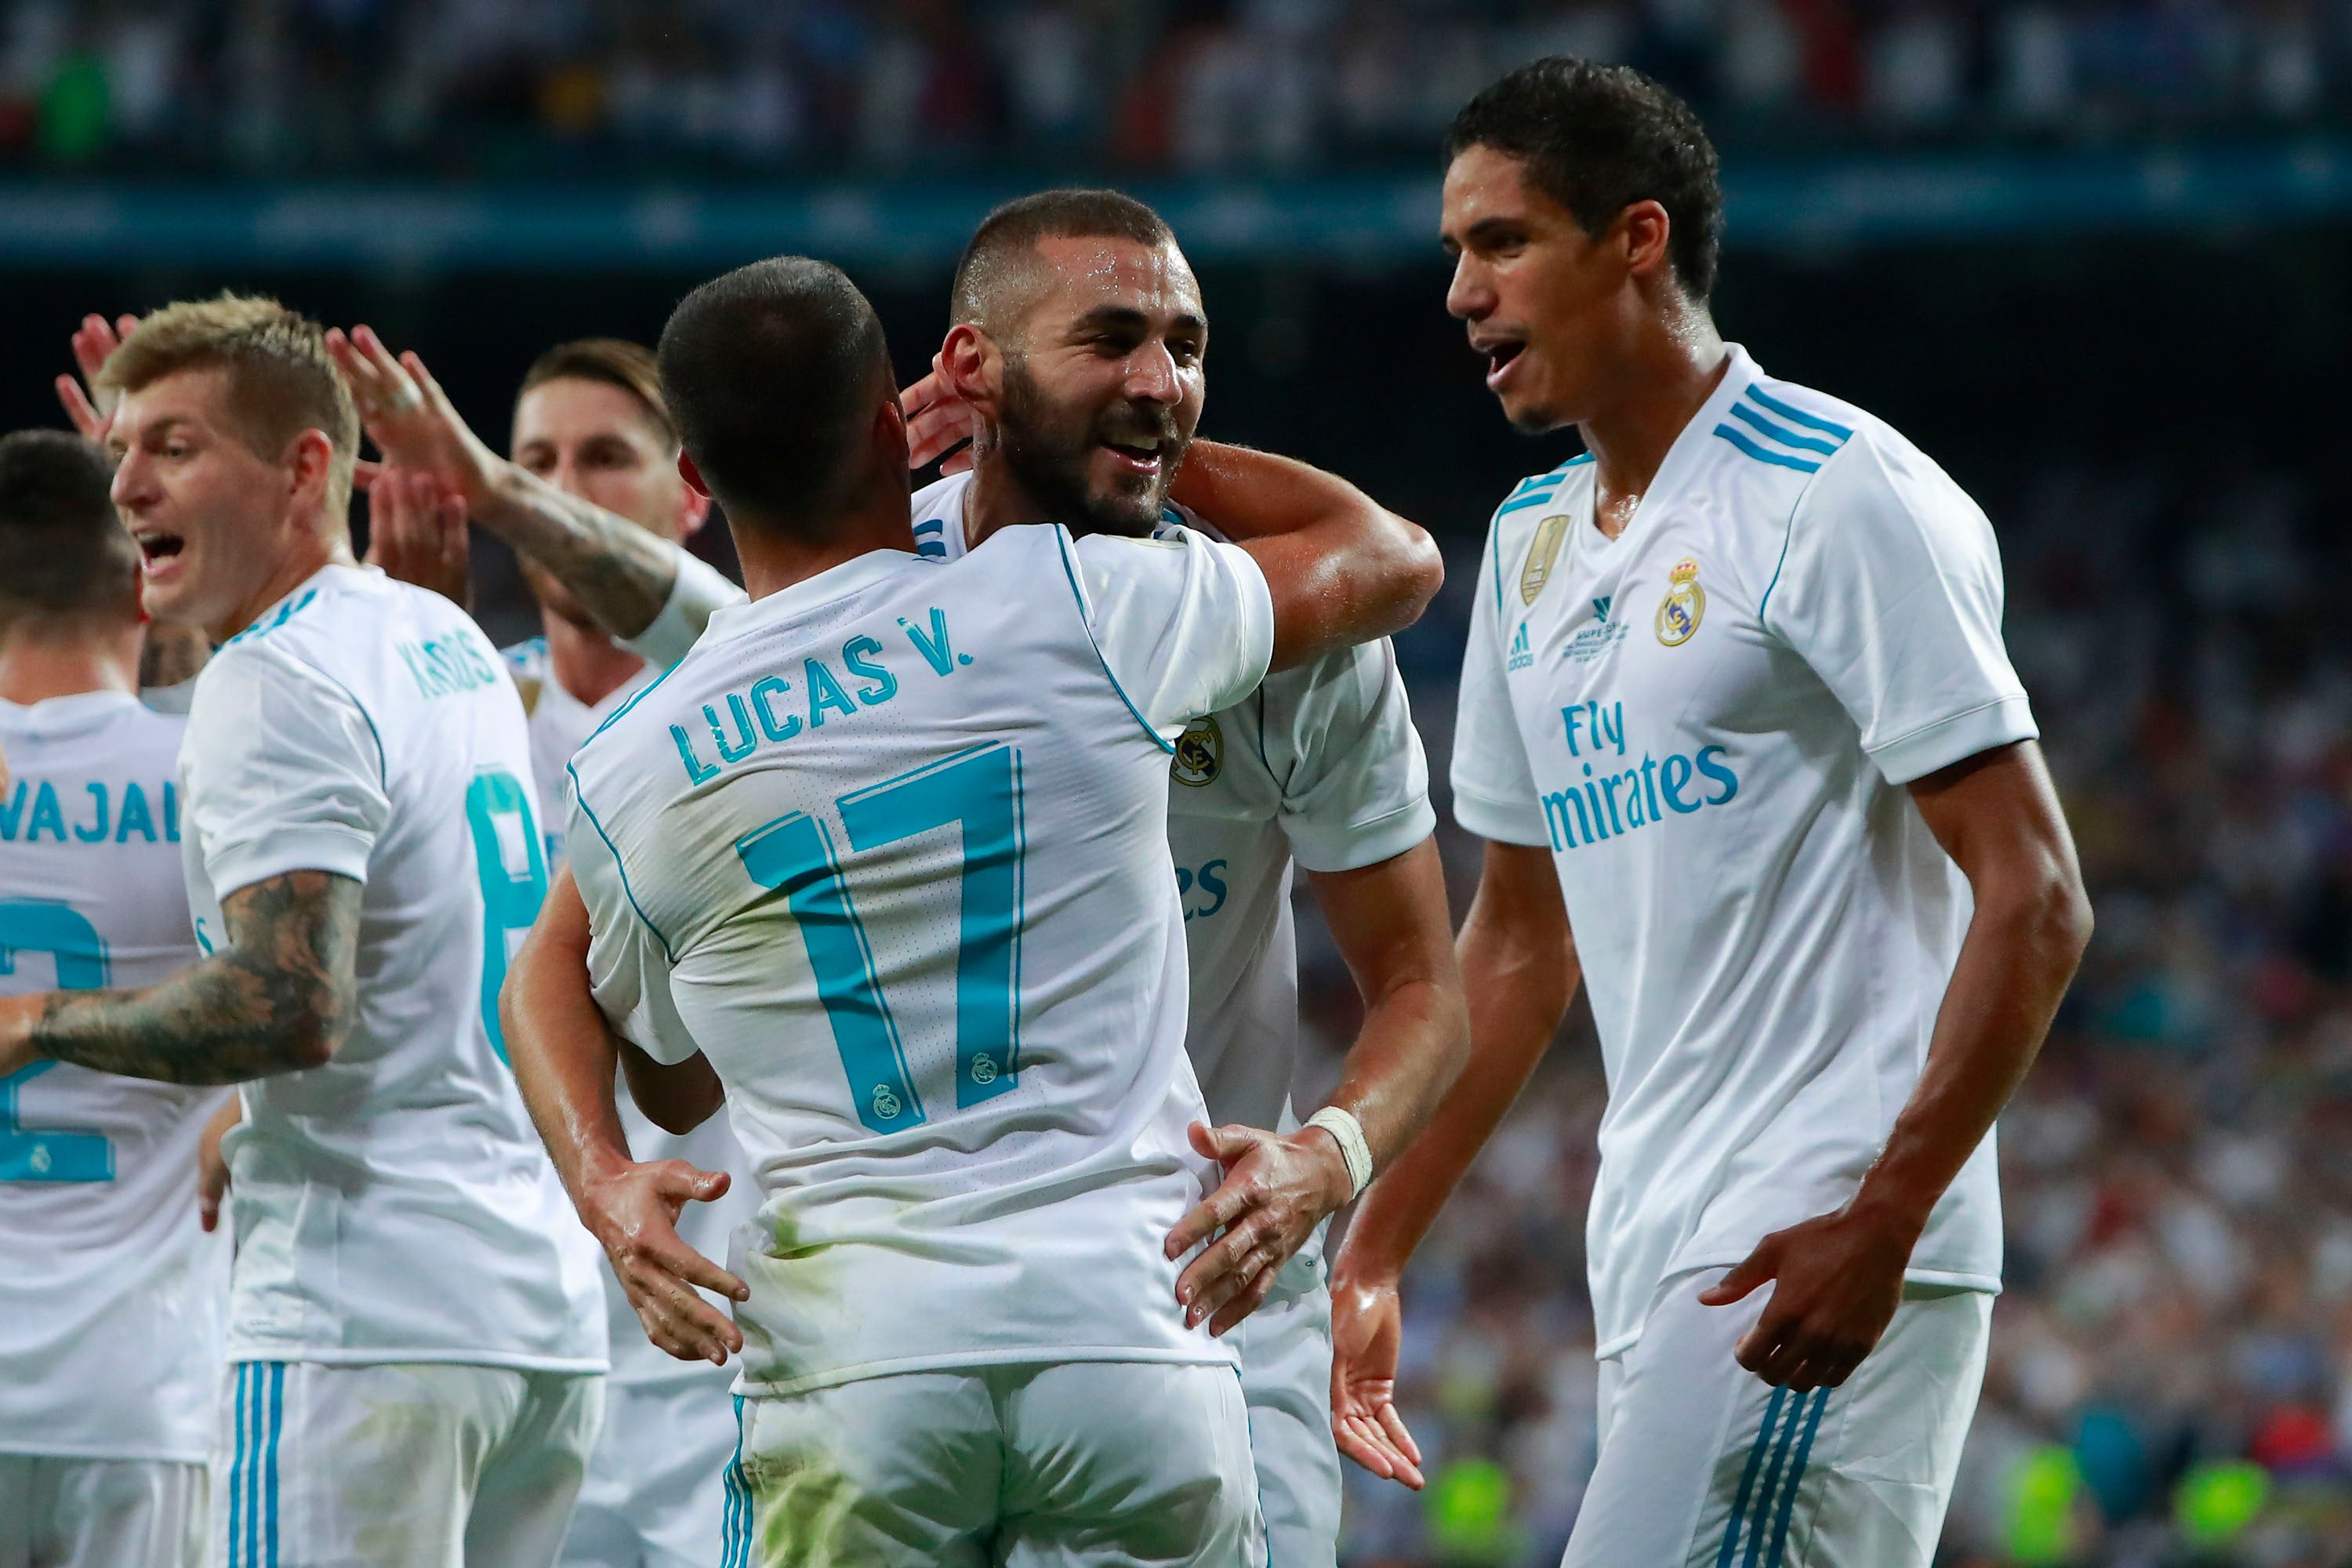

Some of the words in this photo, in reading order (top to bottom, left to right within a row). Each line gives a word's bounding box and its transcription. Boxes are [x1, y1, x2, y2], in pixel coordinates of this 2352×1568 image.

[668, 634, 898, 787] LUCAS
[897, 606, 975, 677] V.
[1560, 700, 1625, 757] Fly
[0, 897, 117, 1182] 2
[464, 763, 550, 1071] 8
[735, 739, 1027, 1136] 17
